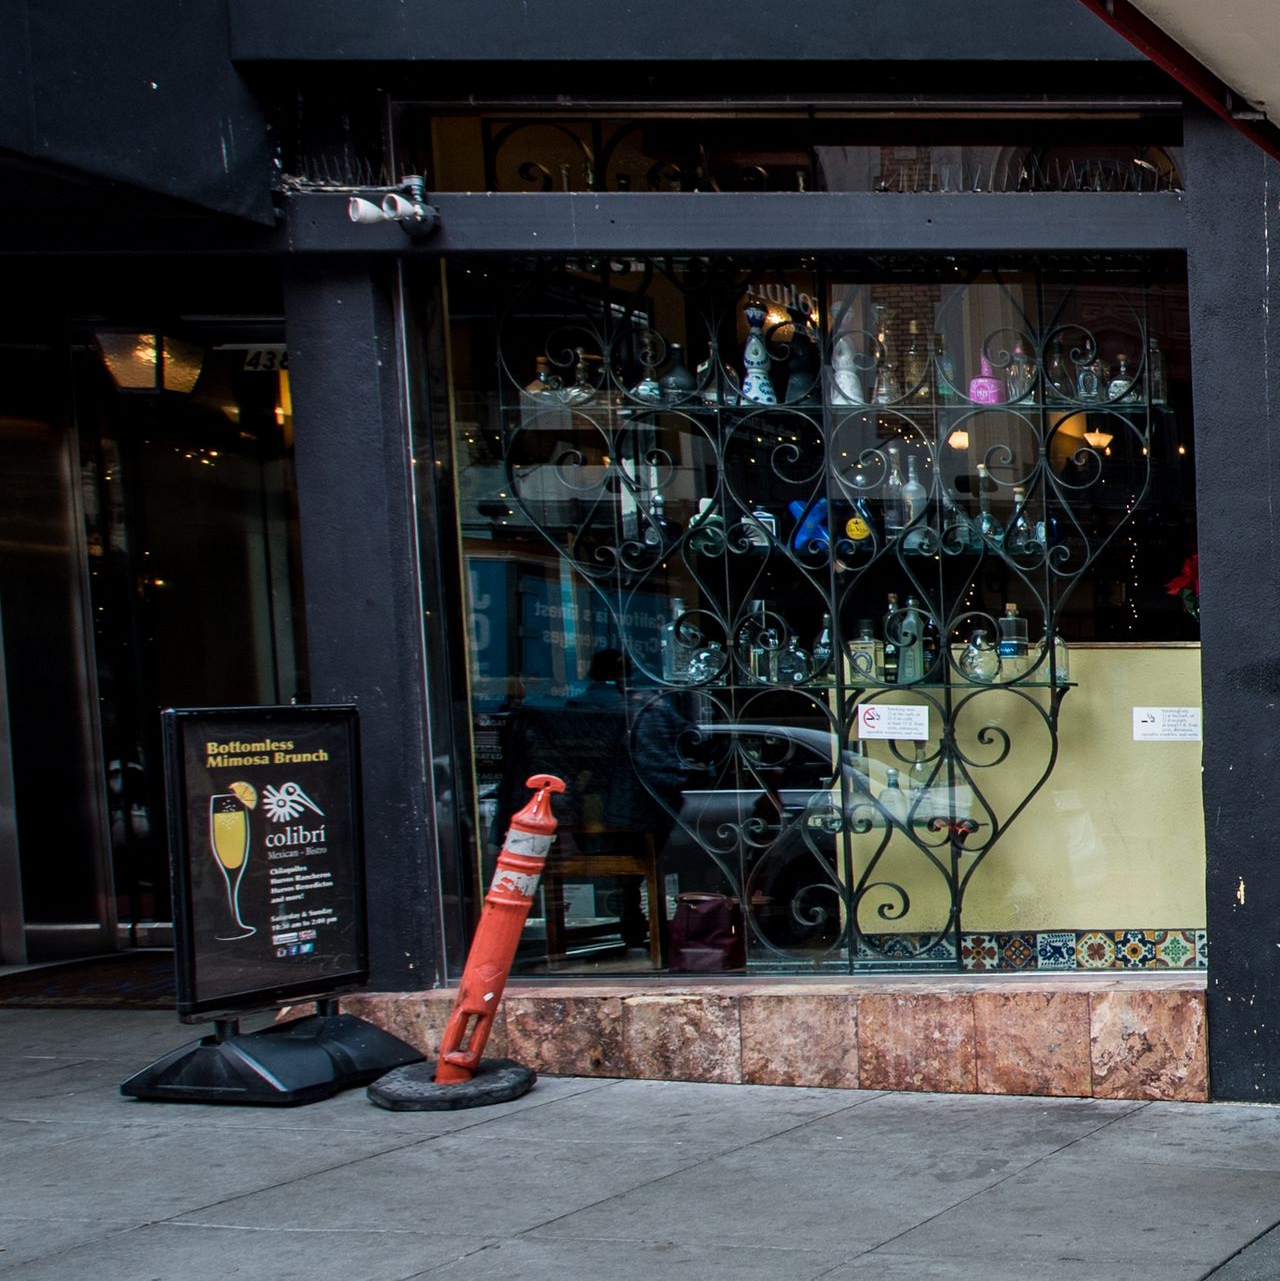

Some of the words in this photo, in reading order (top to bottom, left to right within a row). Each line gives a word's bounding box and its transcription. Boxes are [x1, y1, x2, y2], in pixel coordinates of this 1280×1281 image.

[206, 739, 294, 755] Bottomless
[206, 754, 270, 768] Mimosa
[274, 749, 329, 764] Brunch
[265, 825, 326, 847] colibrí
[268, 849, 299, 860] Mexican
[305, 846, 328, 856] Bistro
